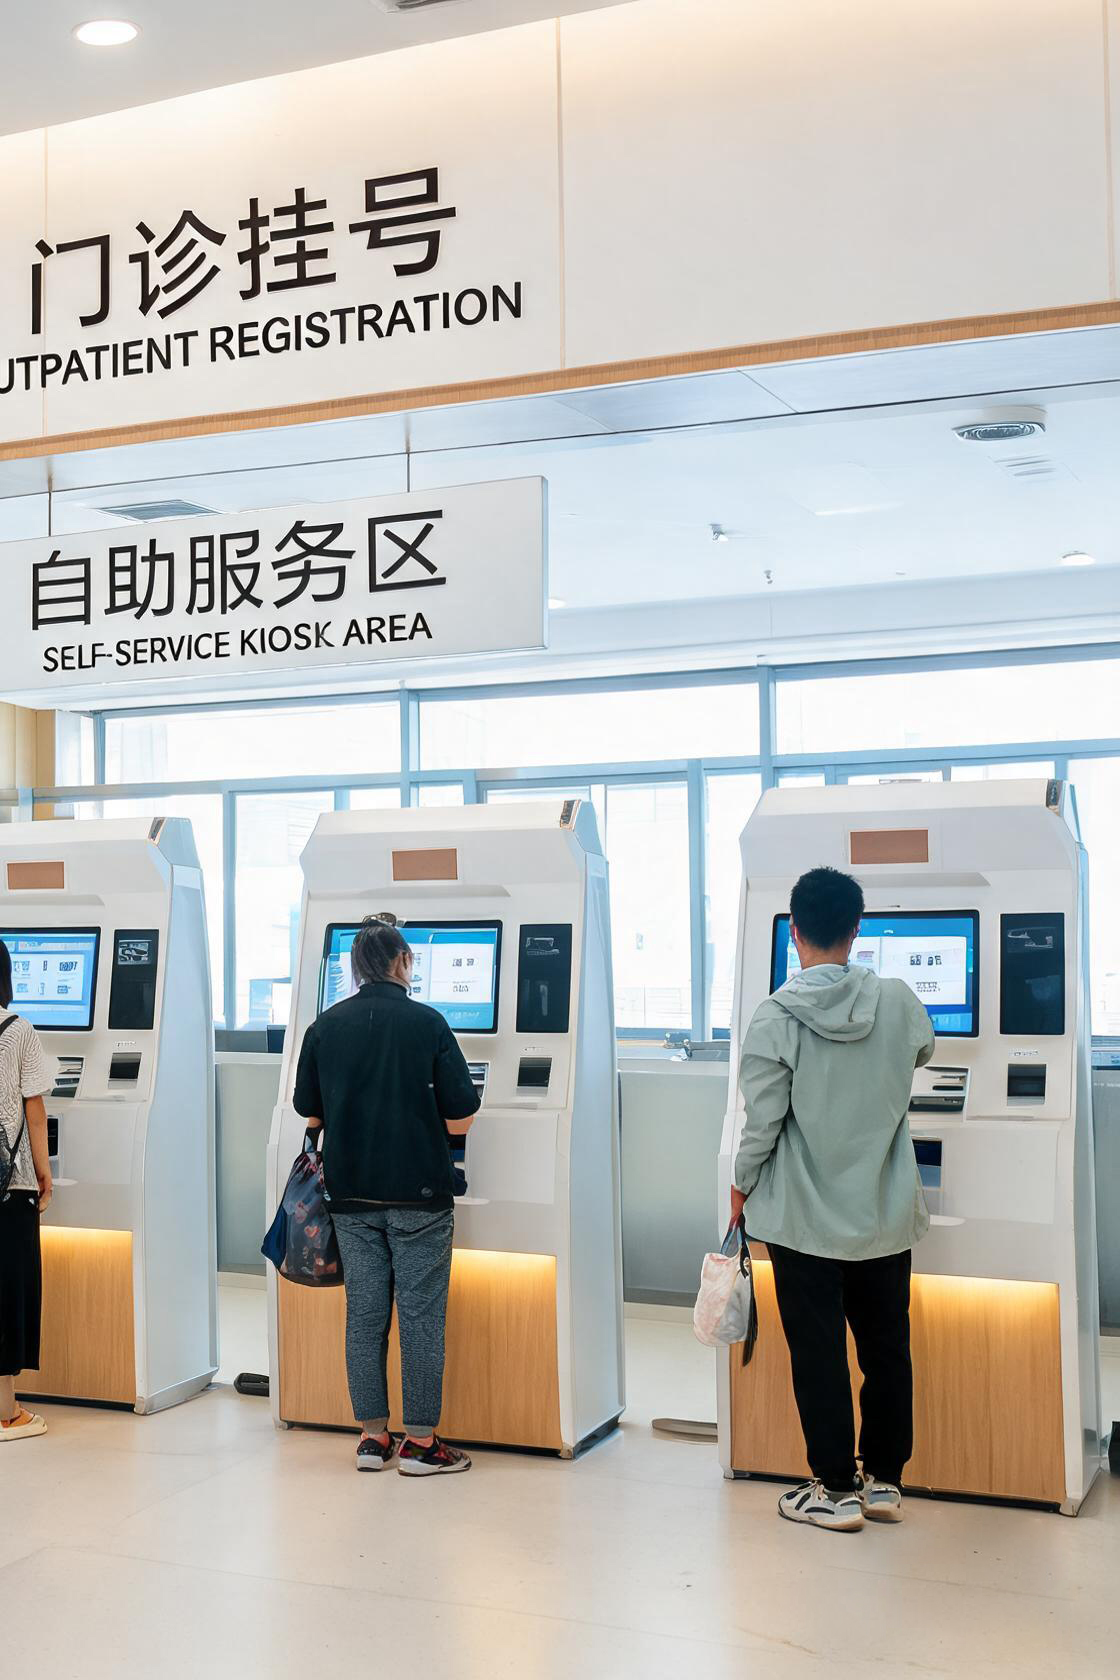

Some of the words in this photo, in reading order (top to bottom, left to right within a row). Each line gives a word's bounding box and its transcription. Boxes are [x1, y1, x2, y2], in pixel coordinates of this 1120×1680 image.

[31, 166, 457, 335] 门诊挂号
[209, 281, 523, 363] REGISTRATION
[31, 509, 447, 631] 自助服务区
[42, 631, 231, 673] SELF-SERVICE
[240, 621, 336, 656] KIOSK
[342, 612, 433, 647] AREA
